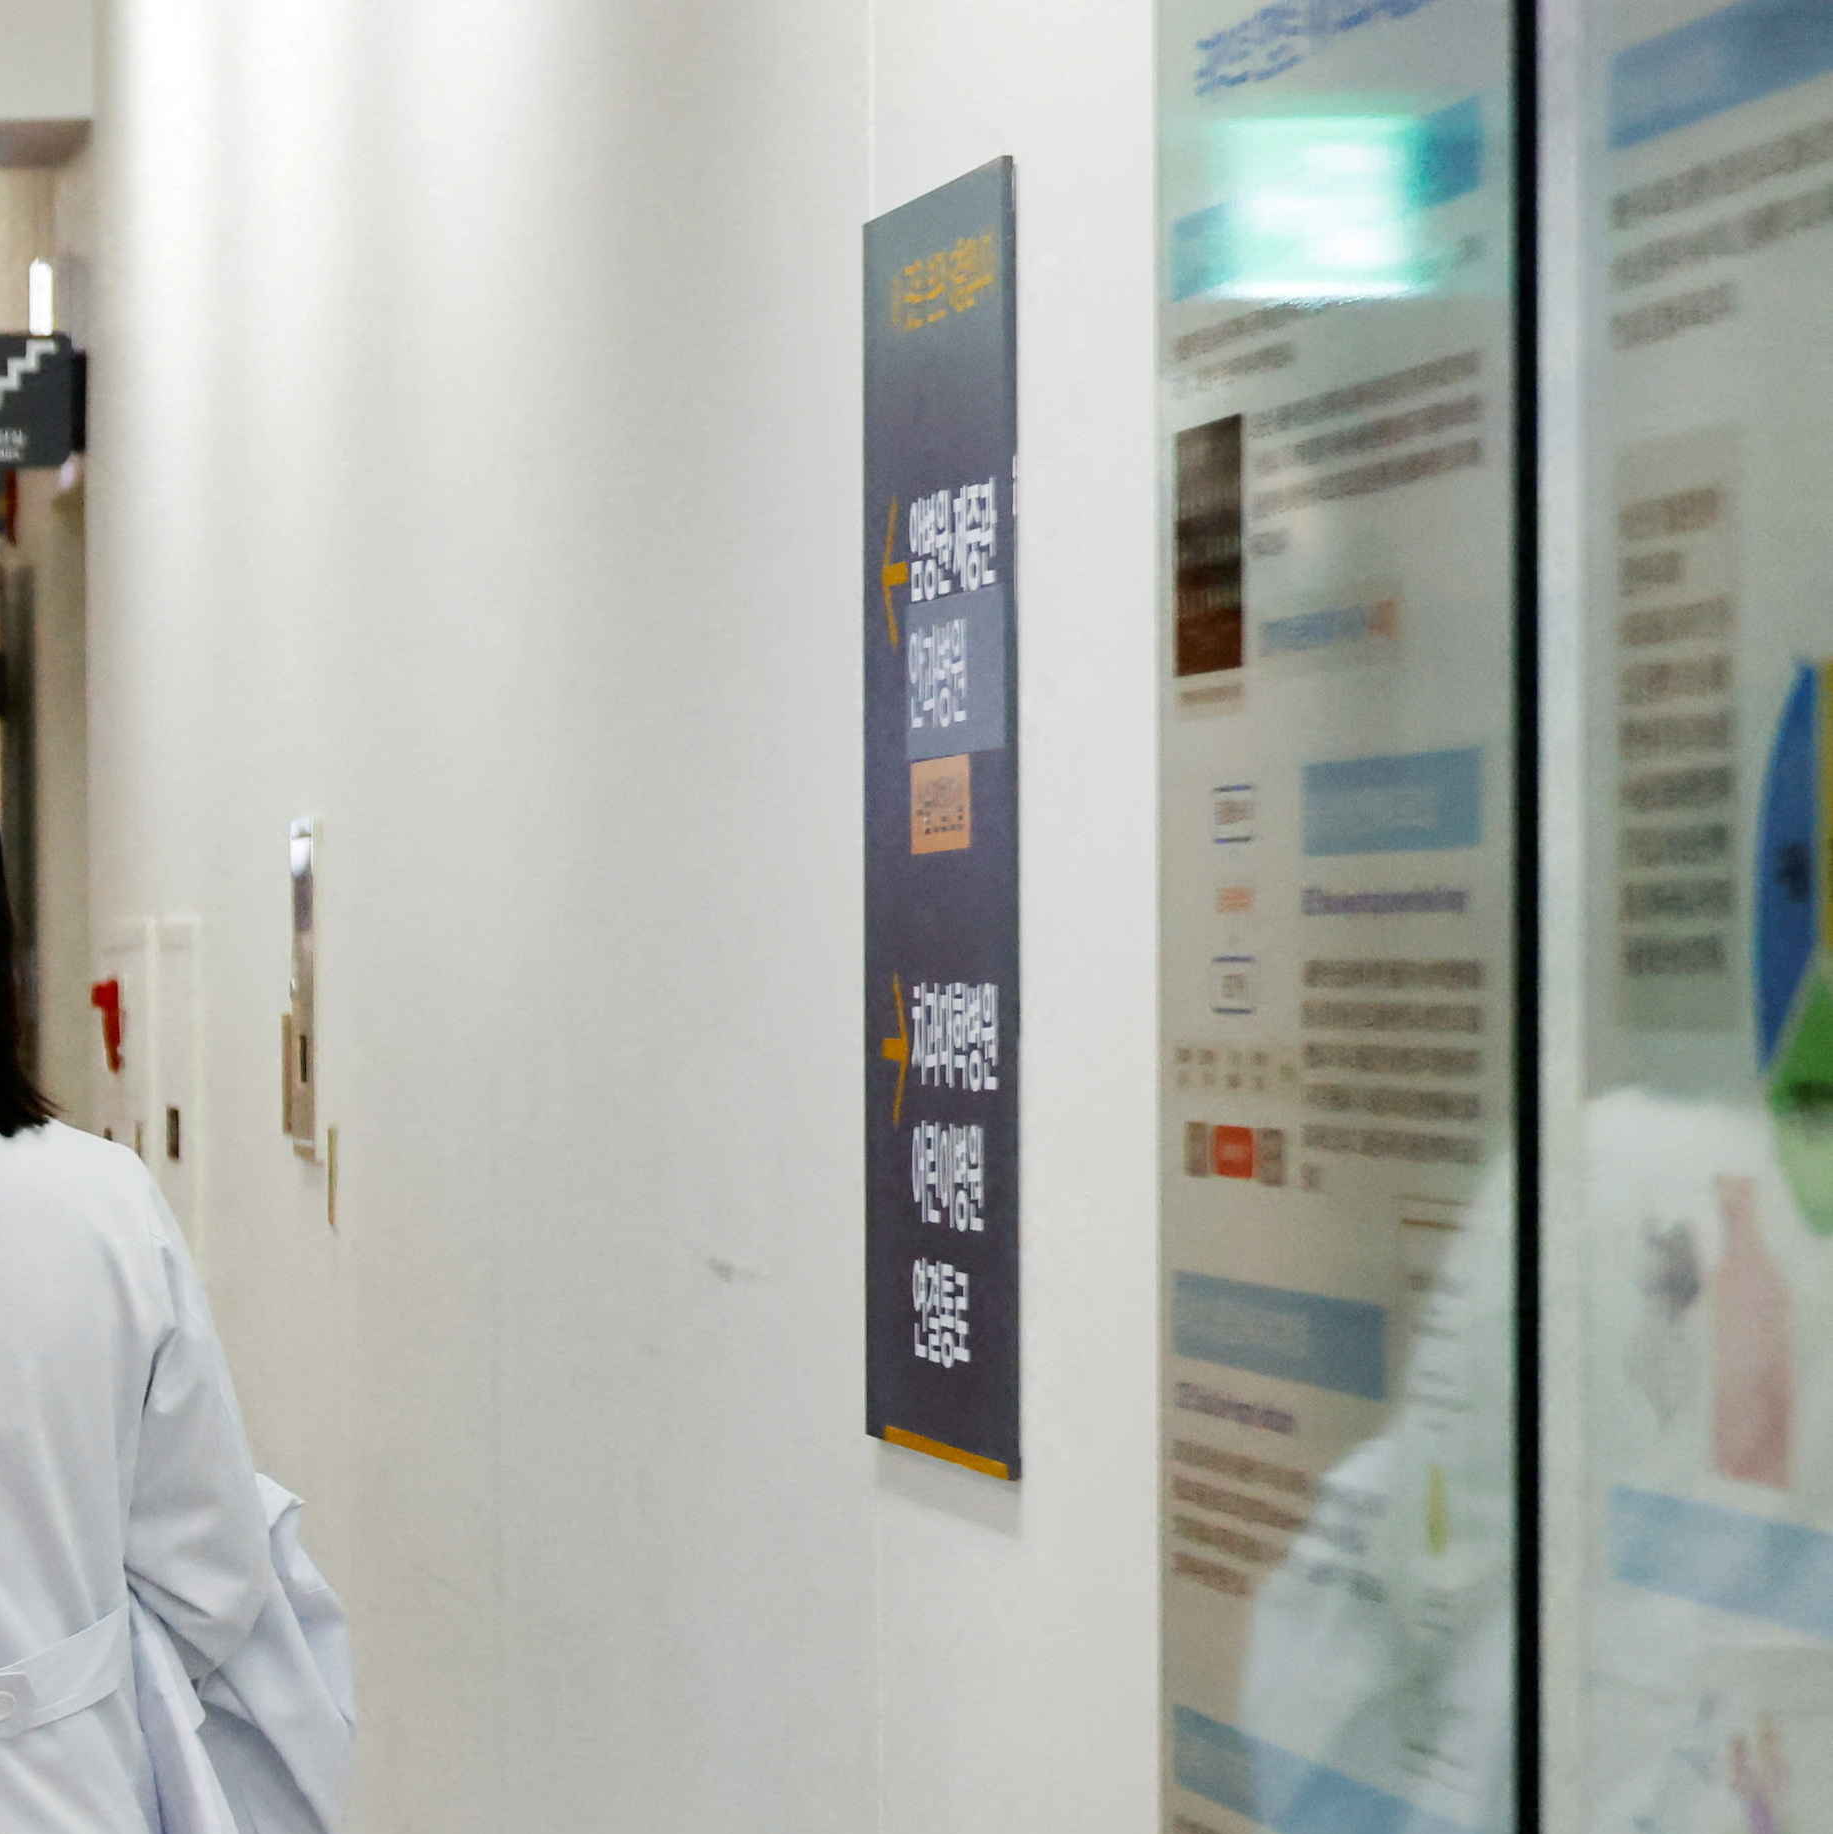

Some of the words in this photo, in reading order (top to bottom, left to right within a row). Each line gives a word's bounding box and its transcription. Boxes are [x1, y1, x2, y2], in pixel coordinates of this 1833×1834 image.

[908, 618, 968, 728] 안과병원
[911, 981, 1000, 1092] 치과대학병원
[912, 1119, 985, 1232] 어린이병원
[912, 1257, 972, 1369] 연결통로
